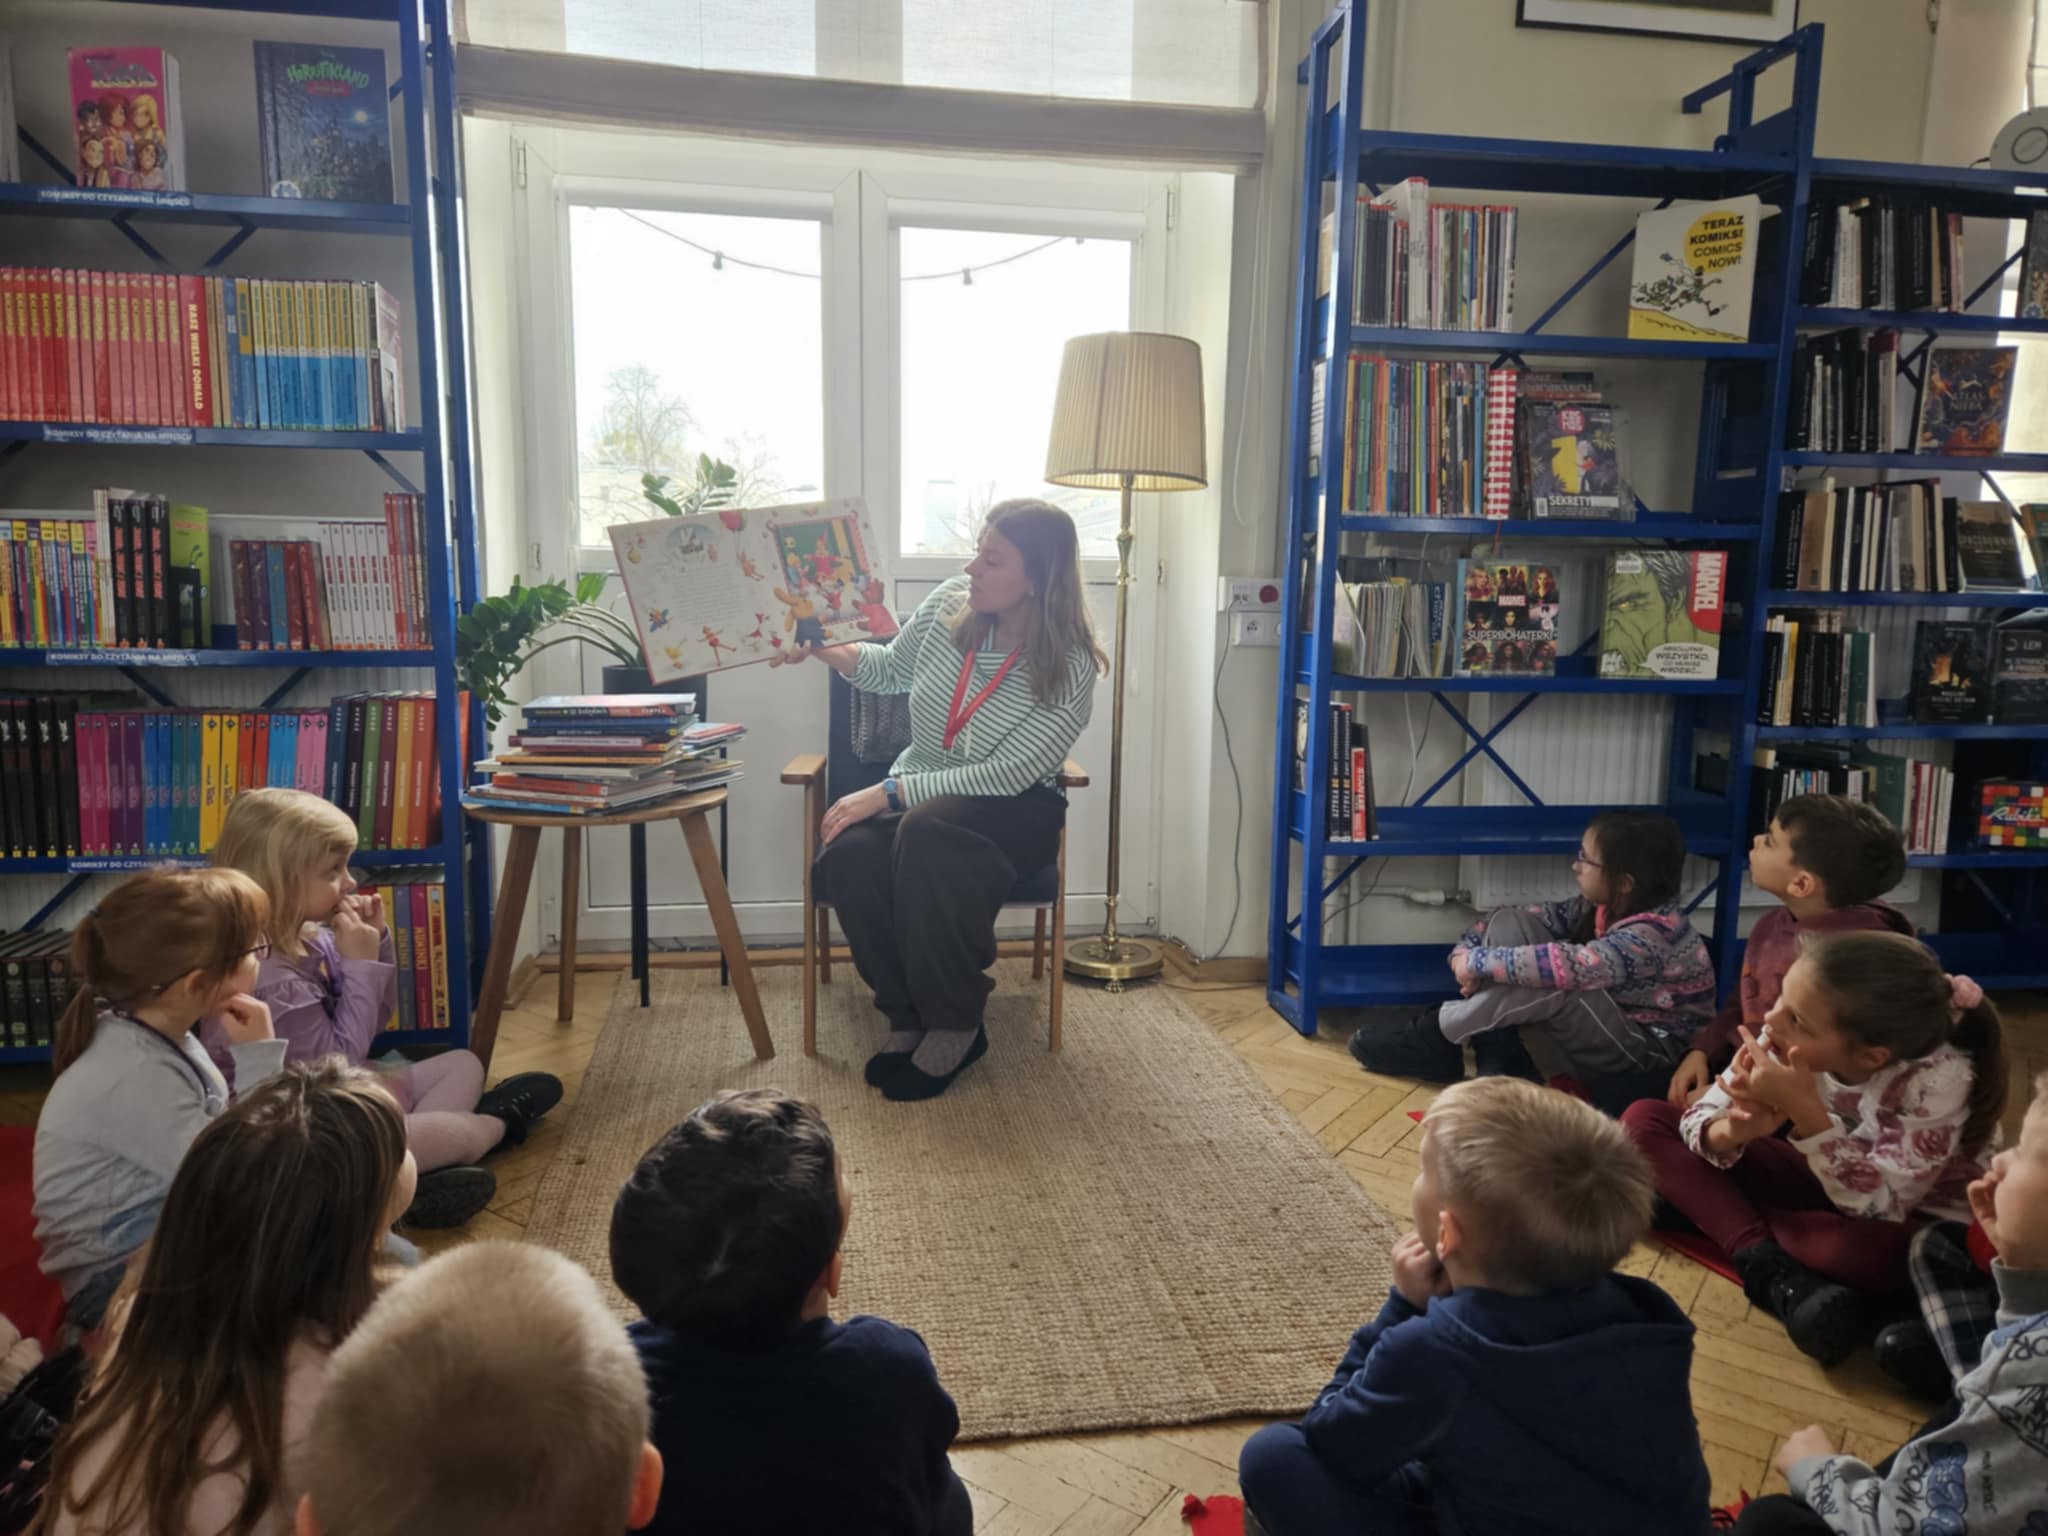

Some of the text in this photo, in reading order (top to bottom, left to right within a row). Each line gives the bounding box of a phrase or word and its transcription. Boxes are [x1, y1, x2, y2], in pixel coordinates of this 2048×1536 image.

[1702, 215, 1744, 230] TERAZ
[1689, 229, 1744, 246] KOMIKS!
[1694, 242, 1742, 257] COMICS
[1709, 256, 1741, 268] NOW!
[188, 304, 203, 410] NASZ WIELKI DONALD
[1693, 552, 1722, 611] MARVEL
[1467, 629, 1553, 641] SUPERBOHATERKI
[110, 861, 122, 869] DO
